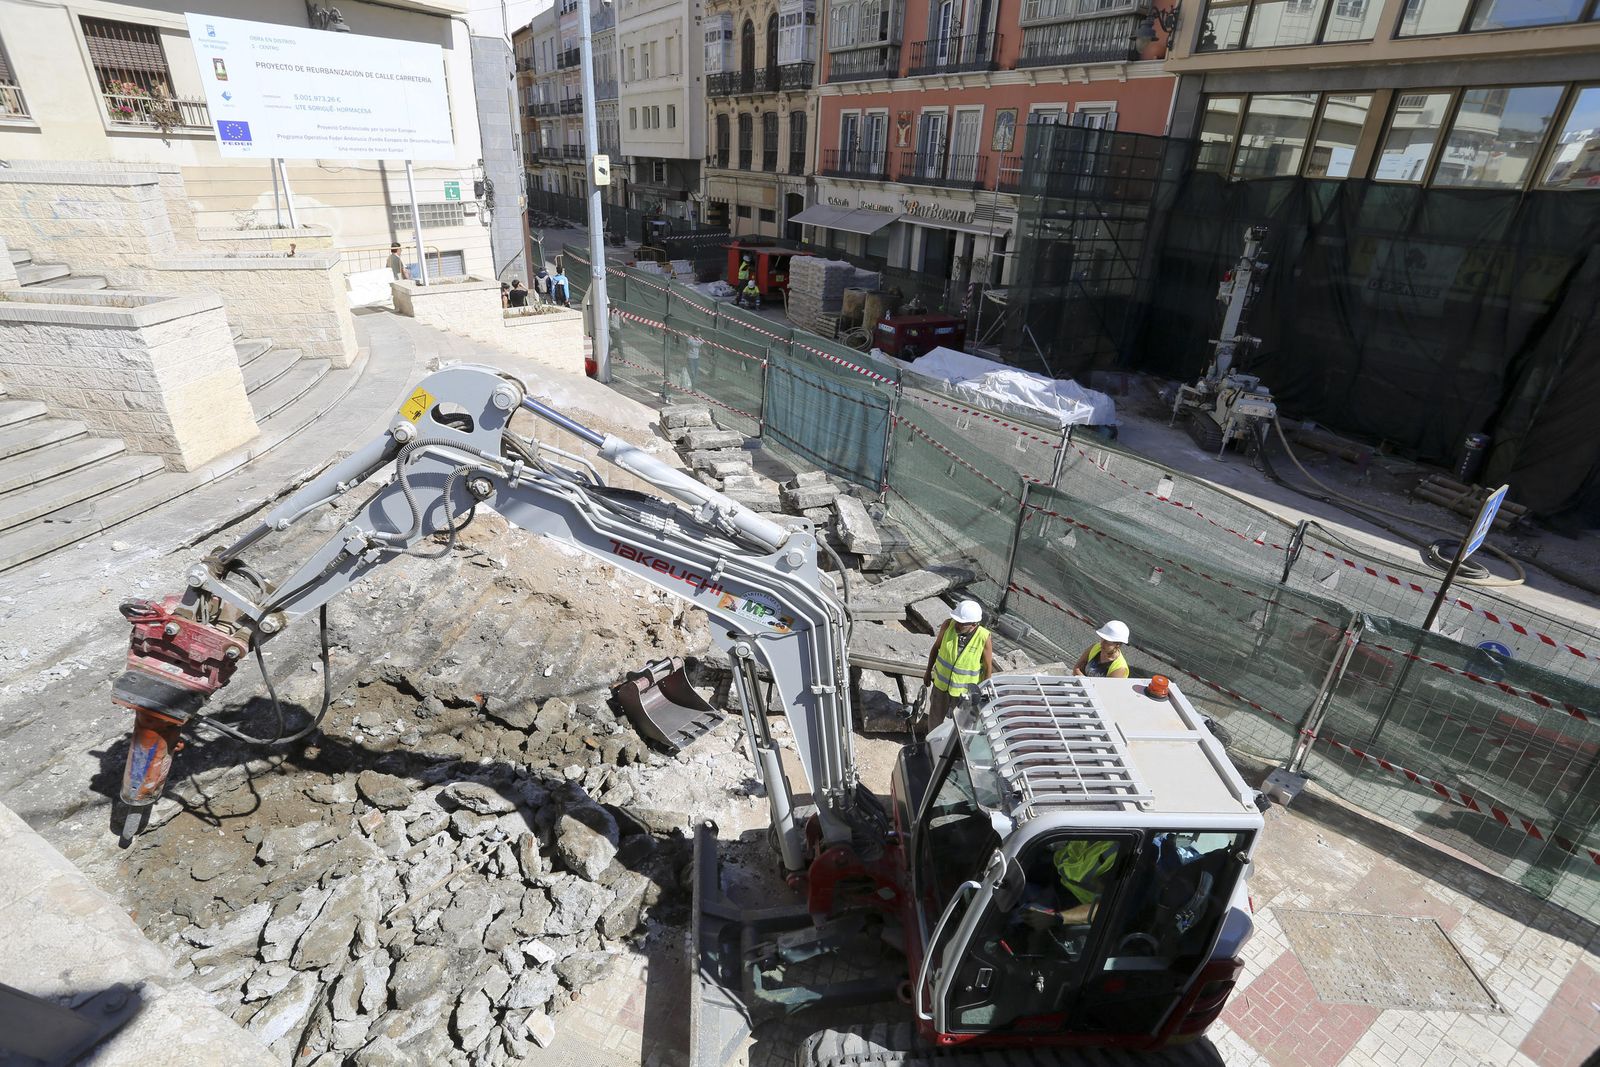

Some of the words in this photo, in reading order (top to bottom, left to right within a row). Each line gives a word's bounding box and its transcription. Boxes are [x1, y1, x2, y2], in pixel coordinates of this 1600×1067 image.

[255, 61, 293, 72] PROYECTO
[295, 65, 304, 73] DE
[306, 65, 364, 78] REURBANIZACIÓN
[365, 71, 374, 79] DE
[375, 72, 394, 81] CALLE
[395, 74, 432, 84] CARRETERÍA
[276, 133, 303, 141] Programa
